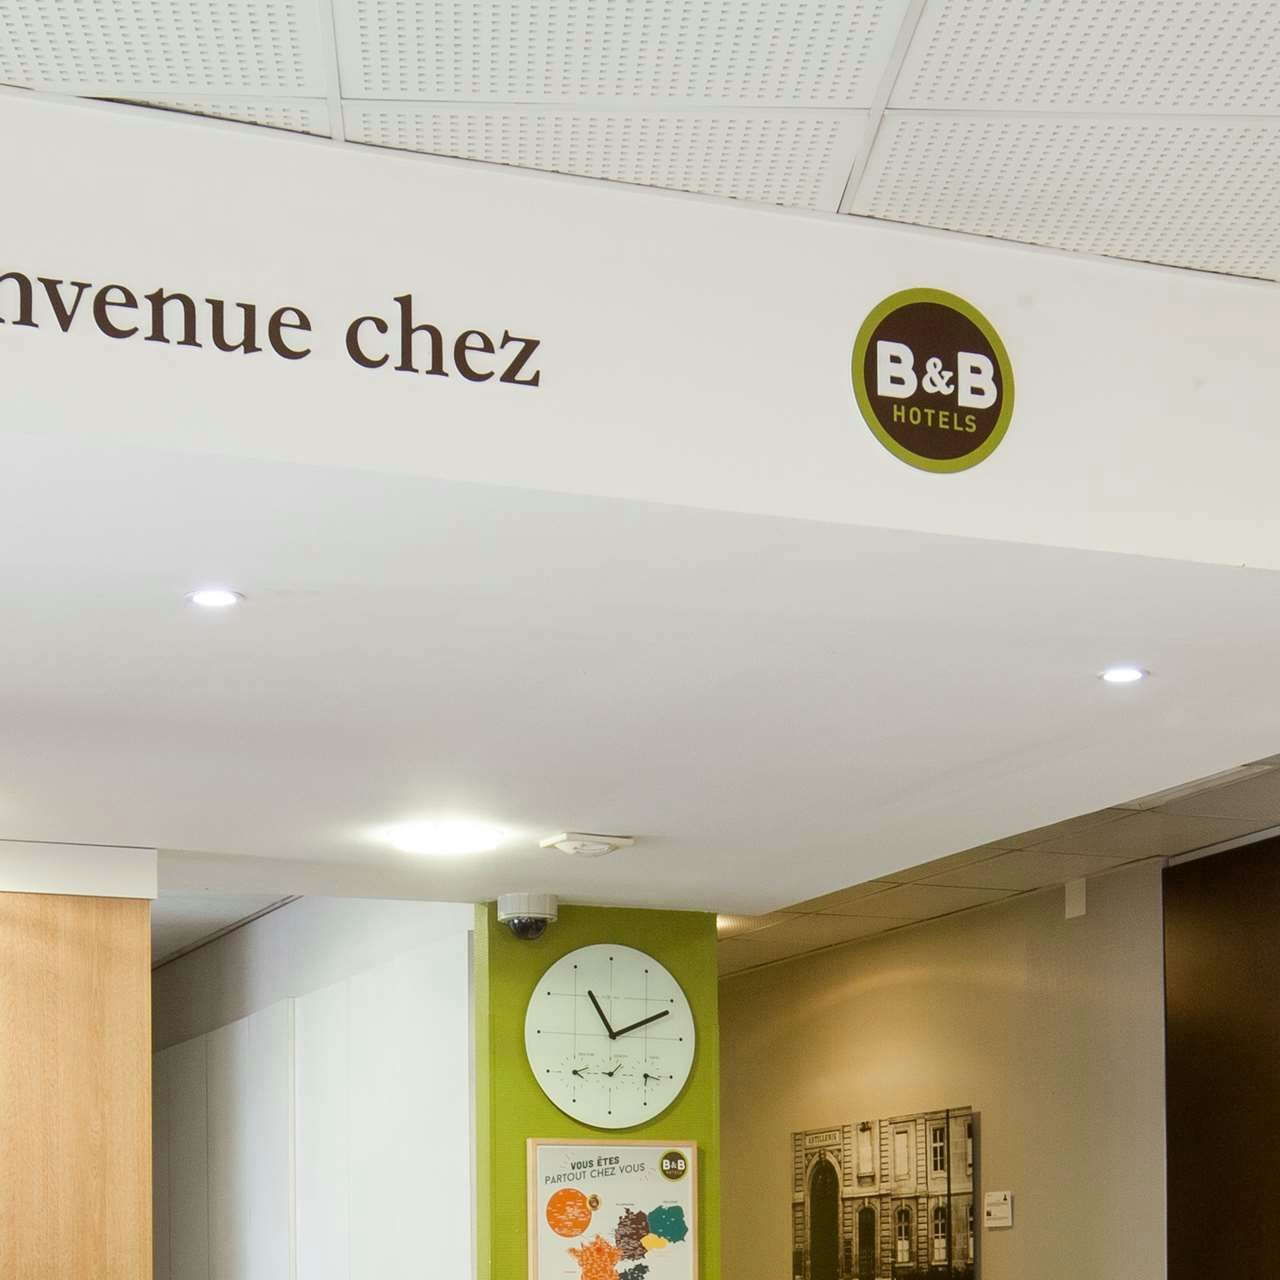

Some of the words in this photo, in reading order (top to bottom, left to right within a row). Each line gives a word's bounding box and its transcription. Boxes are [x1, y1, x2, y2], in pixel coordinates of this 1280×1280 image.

[344, 295, 542, 389] chez
[877, 340, 997, 407] B&B
[892, 404, 978, 434] HOTELS
[545, 1170, 587, 1184] PARTOUT
[590, 1167, 616, 1179] CHEZ
[619, 1162, 646, 1175] VOUS
[571, 1159, 594, 1171] VOUS
[662, 1159, 686, 1171] B&B
